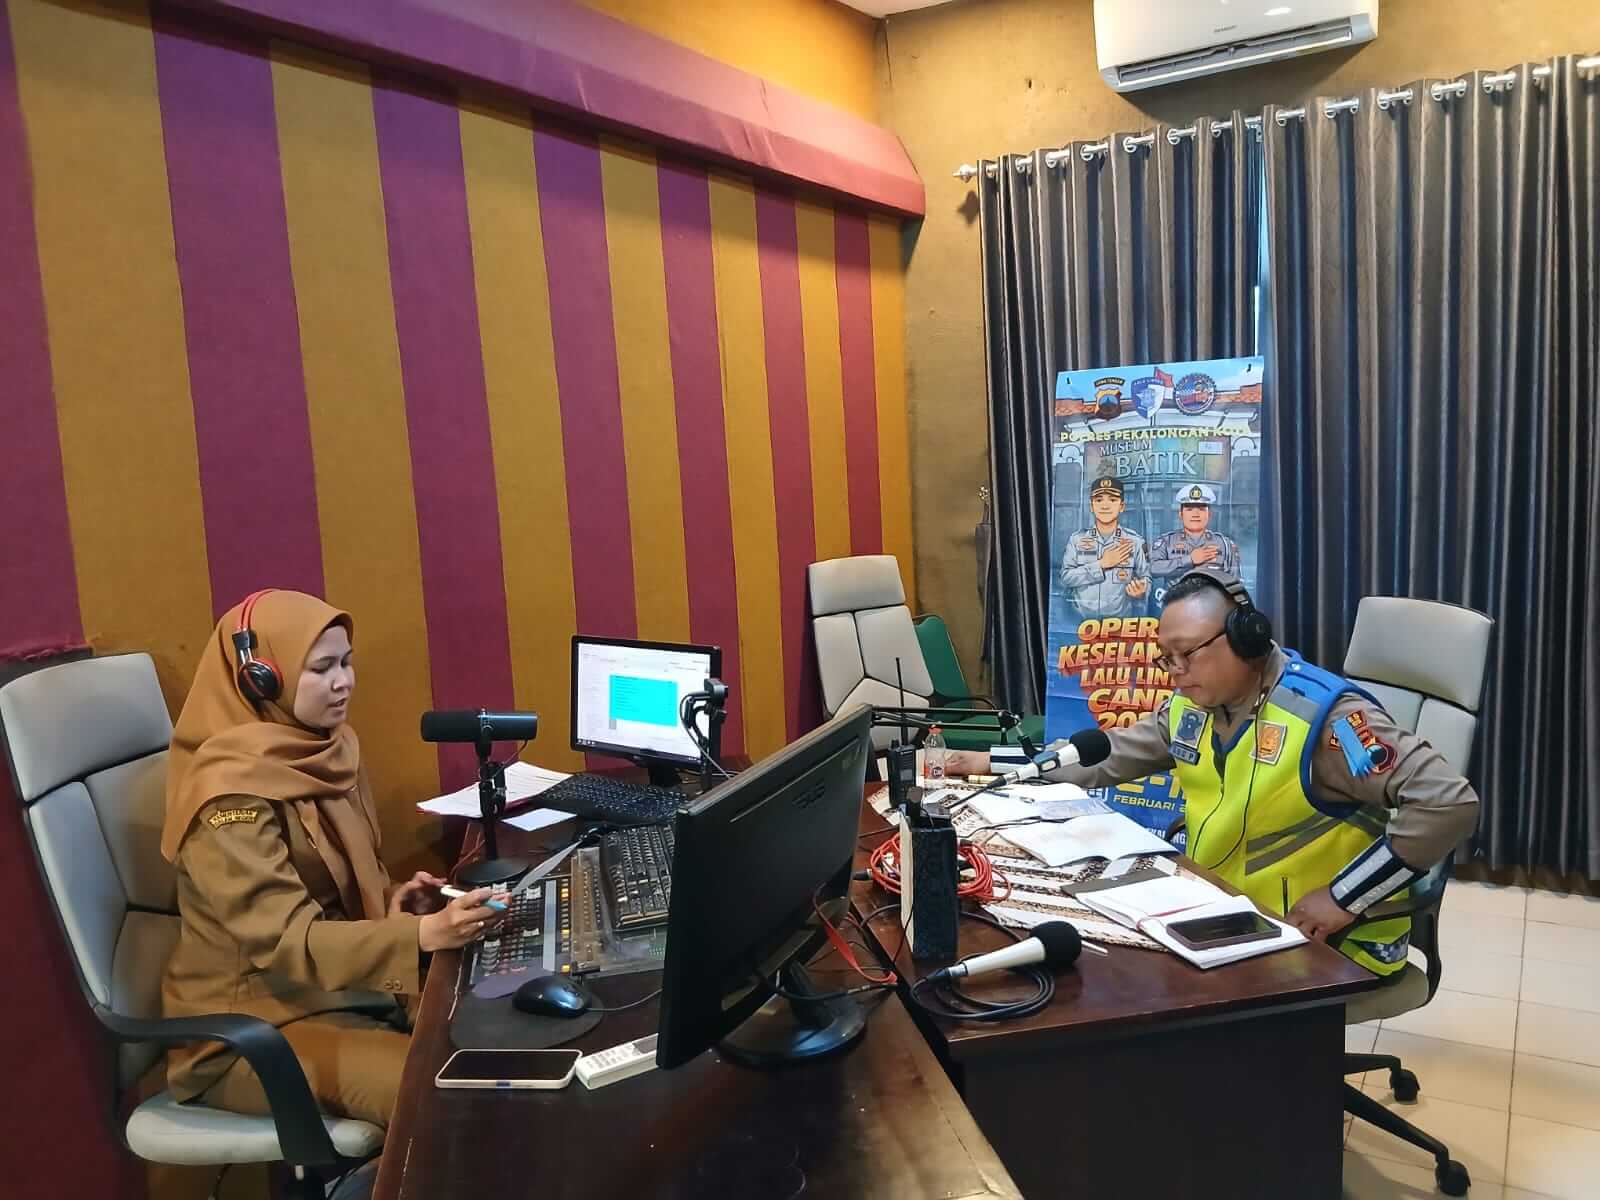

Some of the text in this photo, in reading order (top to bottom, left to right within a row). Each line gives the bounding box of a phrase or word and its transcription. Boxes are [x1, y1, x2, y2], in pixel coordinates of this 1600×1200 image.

[1060, 431, 1110, 442] POLRES
[1114, 427, 1208, 441] PEKALONGAN
[1100, 439, 1152, 457] MUSEUM
[1115, 450, 1199, 477] BATIK
[1080, 667, 1131, 687] LALU
[1113, 795, 1175, 811] FEBRUARI
